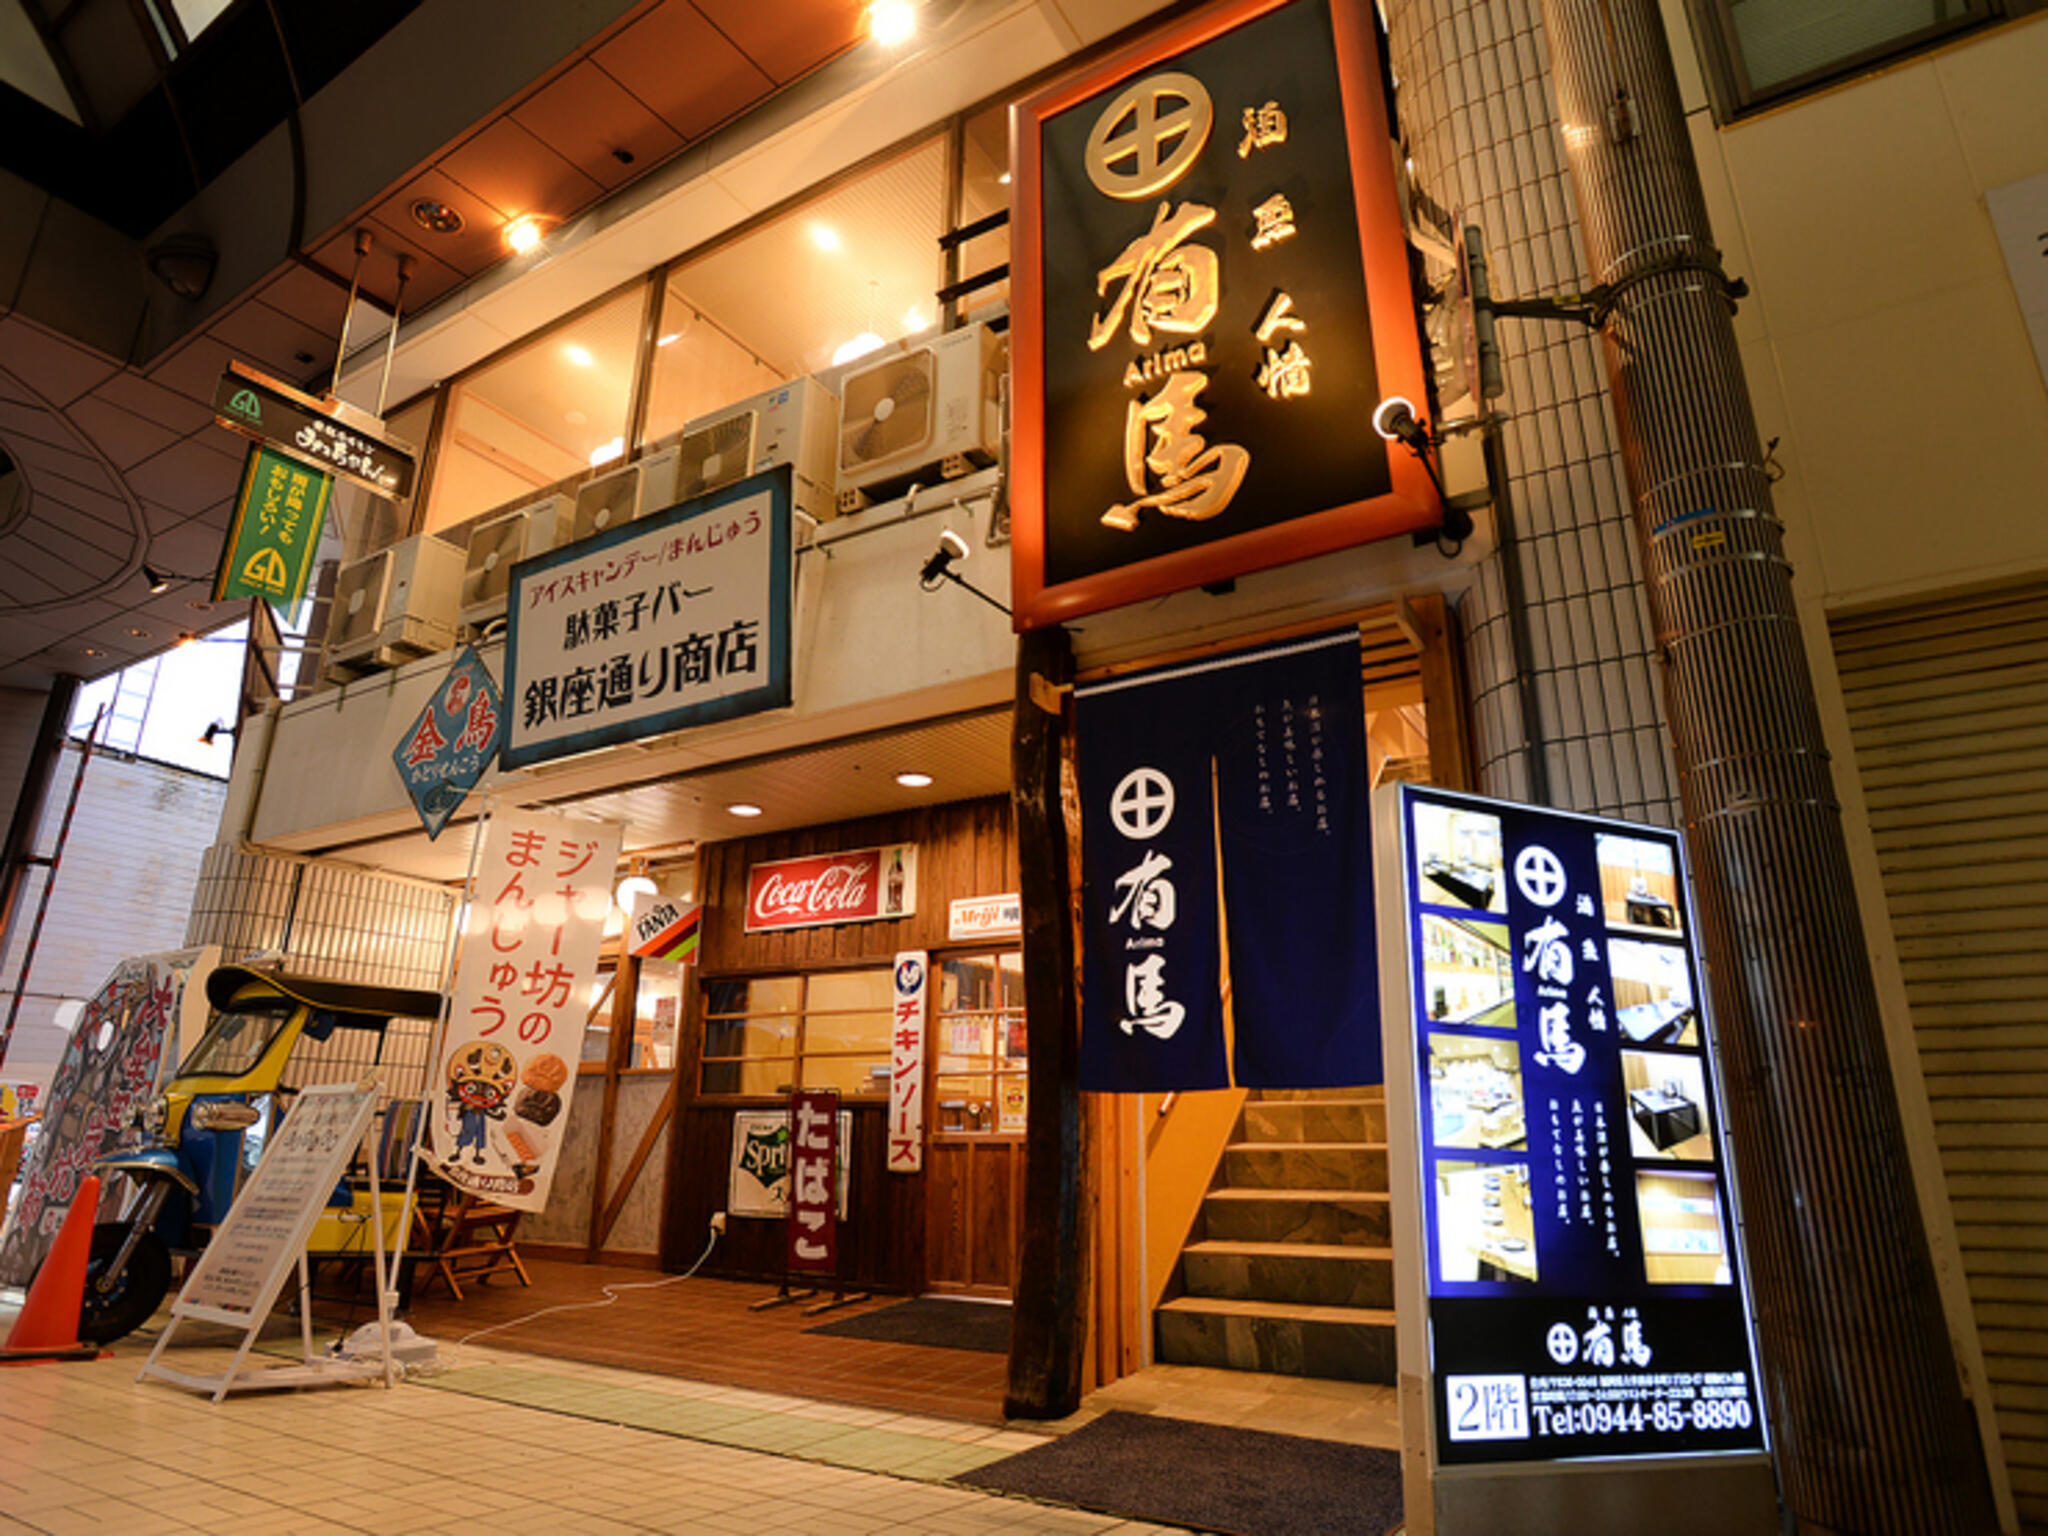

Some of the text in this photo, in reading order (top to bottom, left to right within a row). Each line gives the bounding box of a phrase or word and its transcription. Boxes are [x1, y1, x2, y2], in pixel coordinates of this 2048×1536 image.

[1087, 200, 1251, 532] 有馬
[1123, 341, 1208, 388] Arima
[563, 580, 715, 652] 駄菓子バー
[523, 619, 761, 731] 銀座通り商店
[754, 862, 874, 919] Coca-Cola
[517, 839, 600, 1046] ジャー坊の
[1108, 849, 1186, 1040] 有馬
[1522, 914, 1588, 1076] 有馬
[891, 999, 921, 1165] チキンソース
[746, 1139, 786, 1176] Spri
[794, 1101, 830, 1260] たばこ
[1581, 1318, 1654, 1369] 有馬
[1455, 1382, 1519, 1432] 2階
[1531, 1398, 1753, 1437] Tel:0944-85-8890
